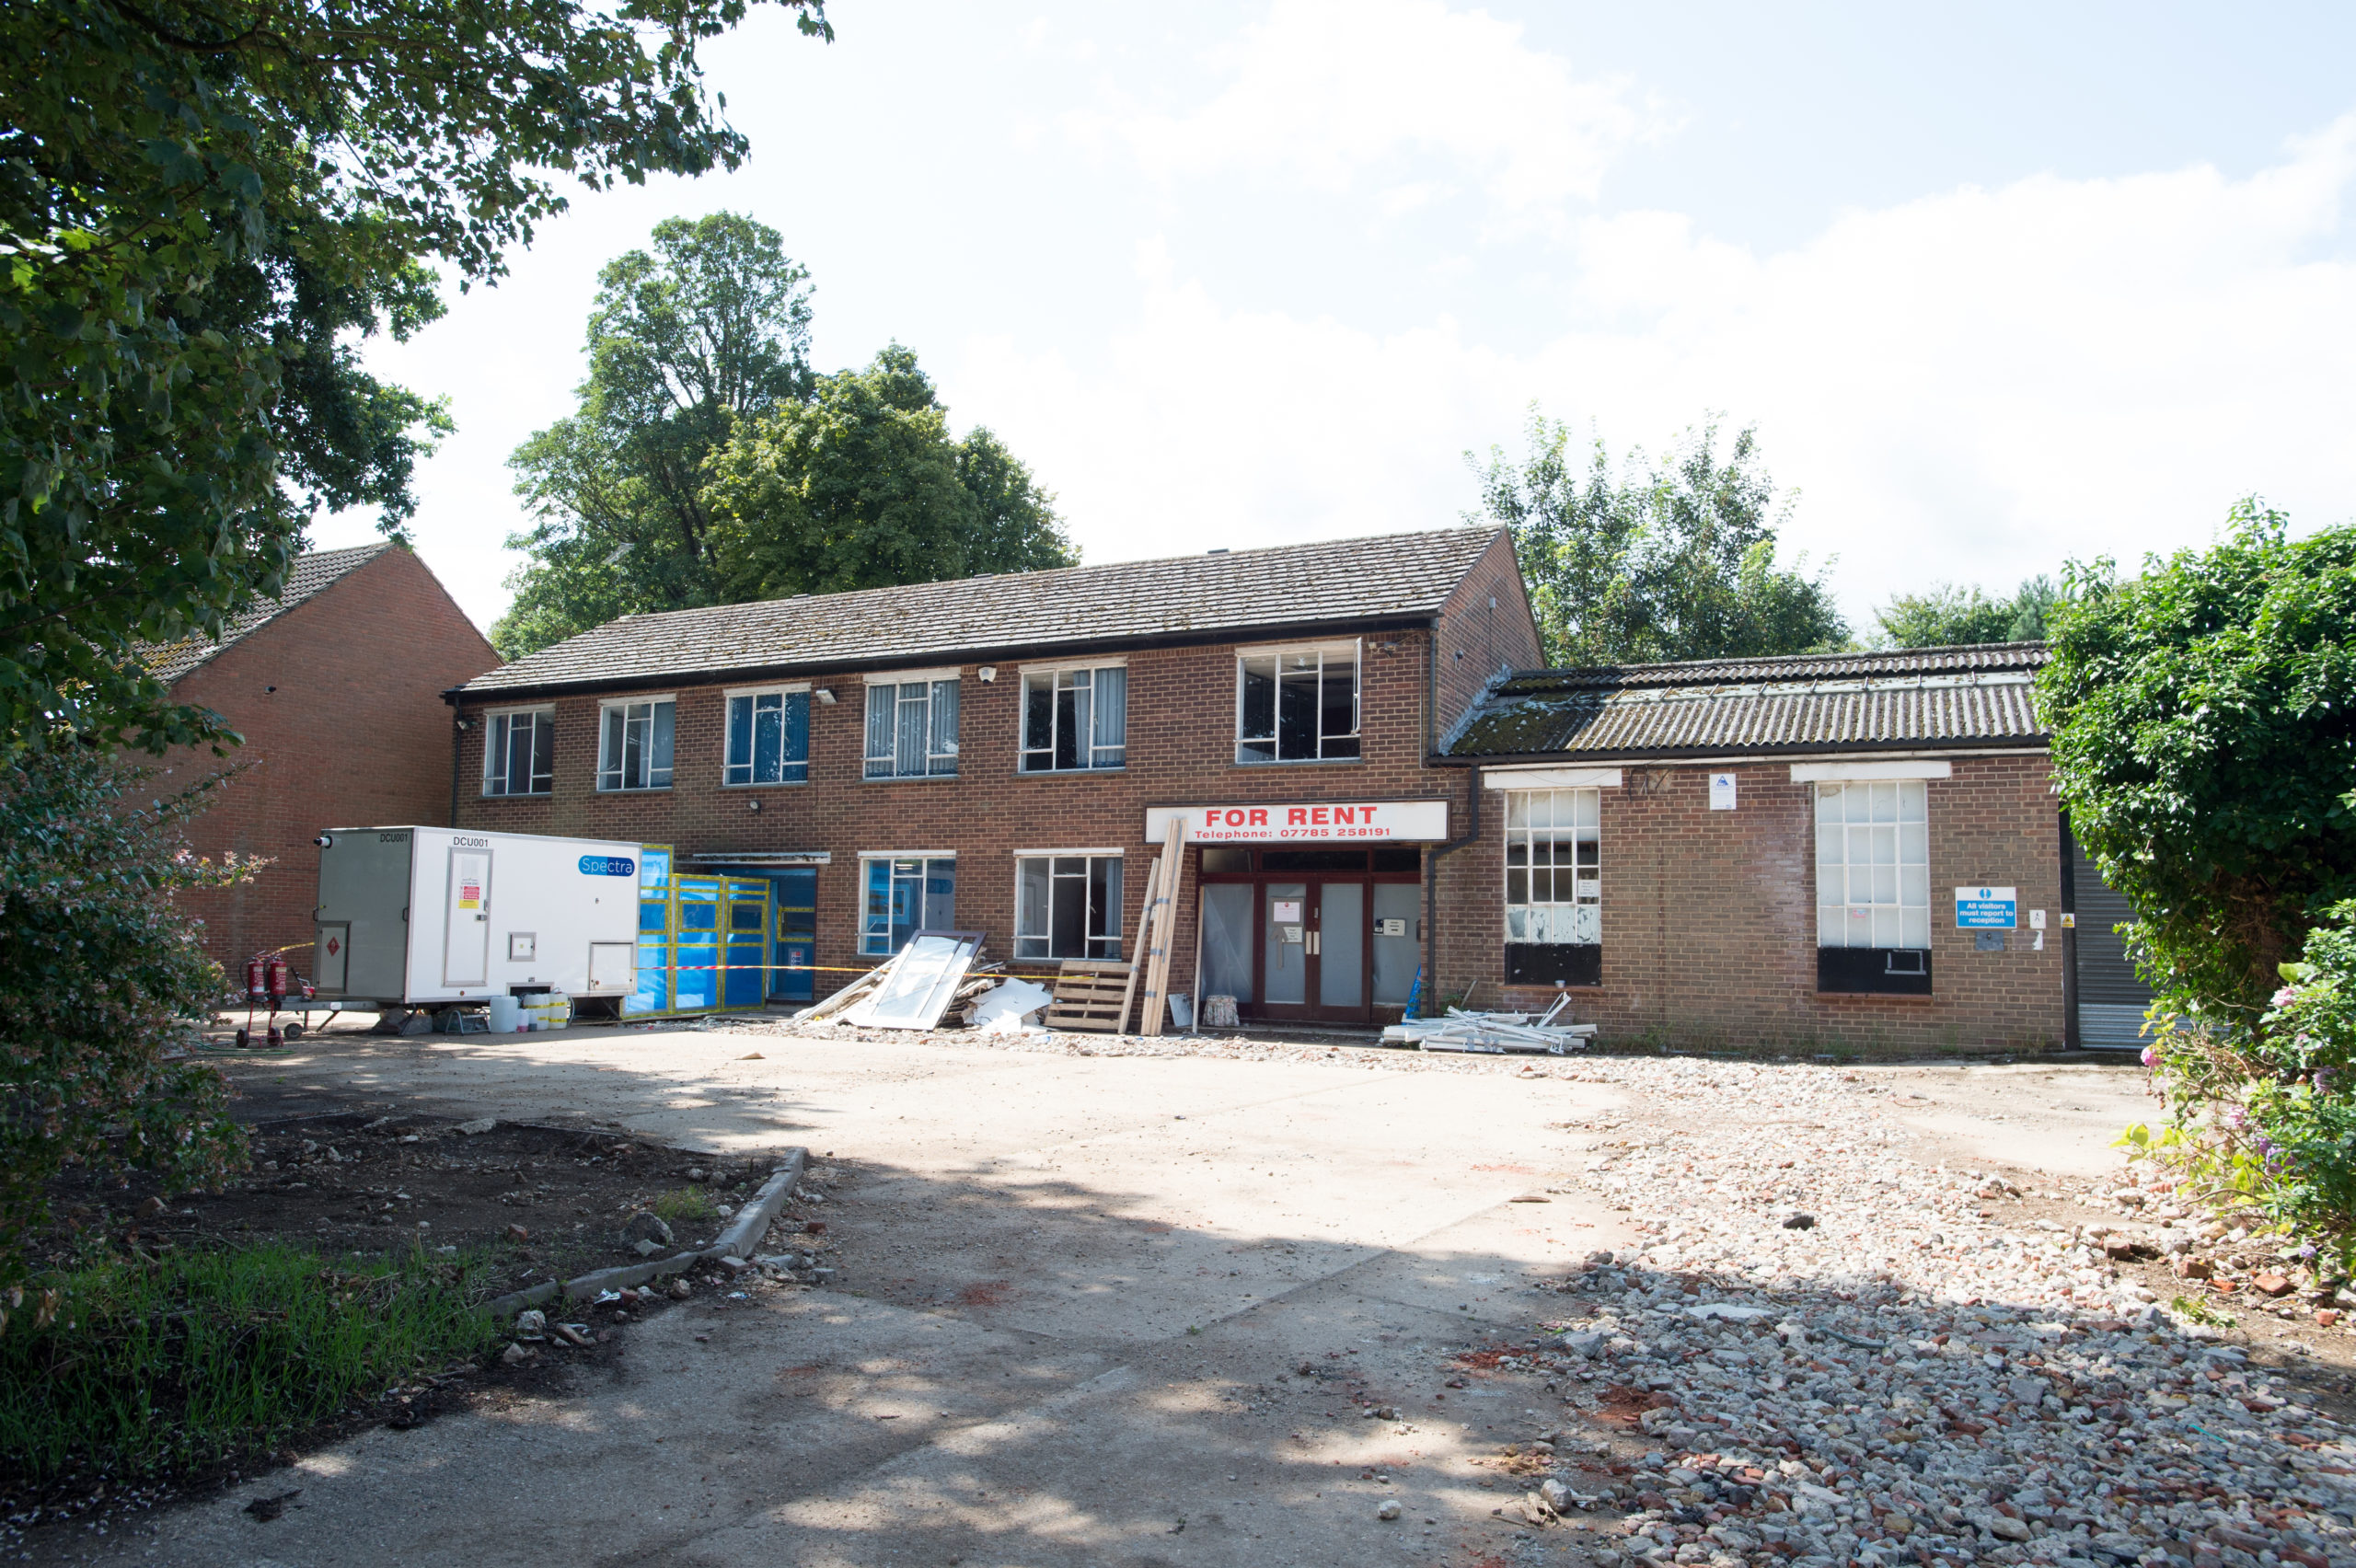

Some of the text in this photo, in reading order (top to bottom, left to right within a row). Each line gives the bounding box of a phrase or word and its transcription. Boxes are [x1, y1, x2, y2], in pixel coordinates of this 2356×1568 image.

[1206, 806, 1378, 827] FOR RENT
[379, 833, 409, 843] DCU001
[1195, 827, 1391, 840] Telephone: 07785 258191
[453, 836, 489, 847] DCU001
[582, 858, 632, 874] Spectra
